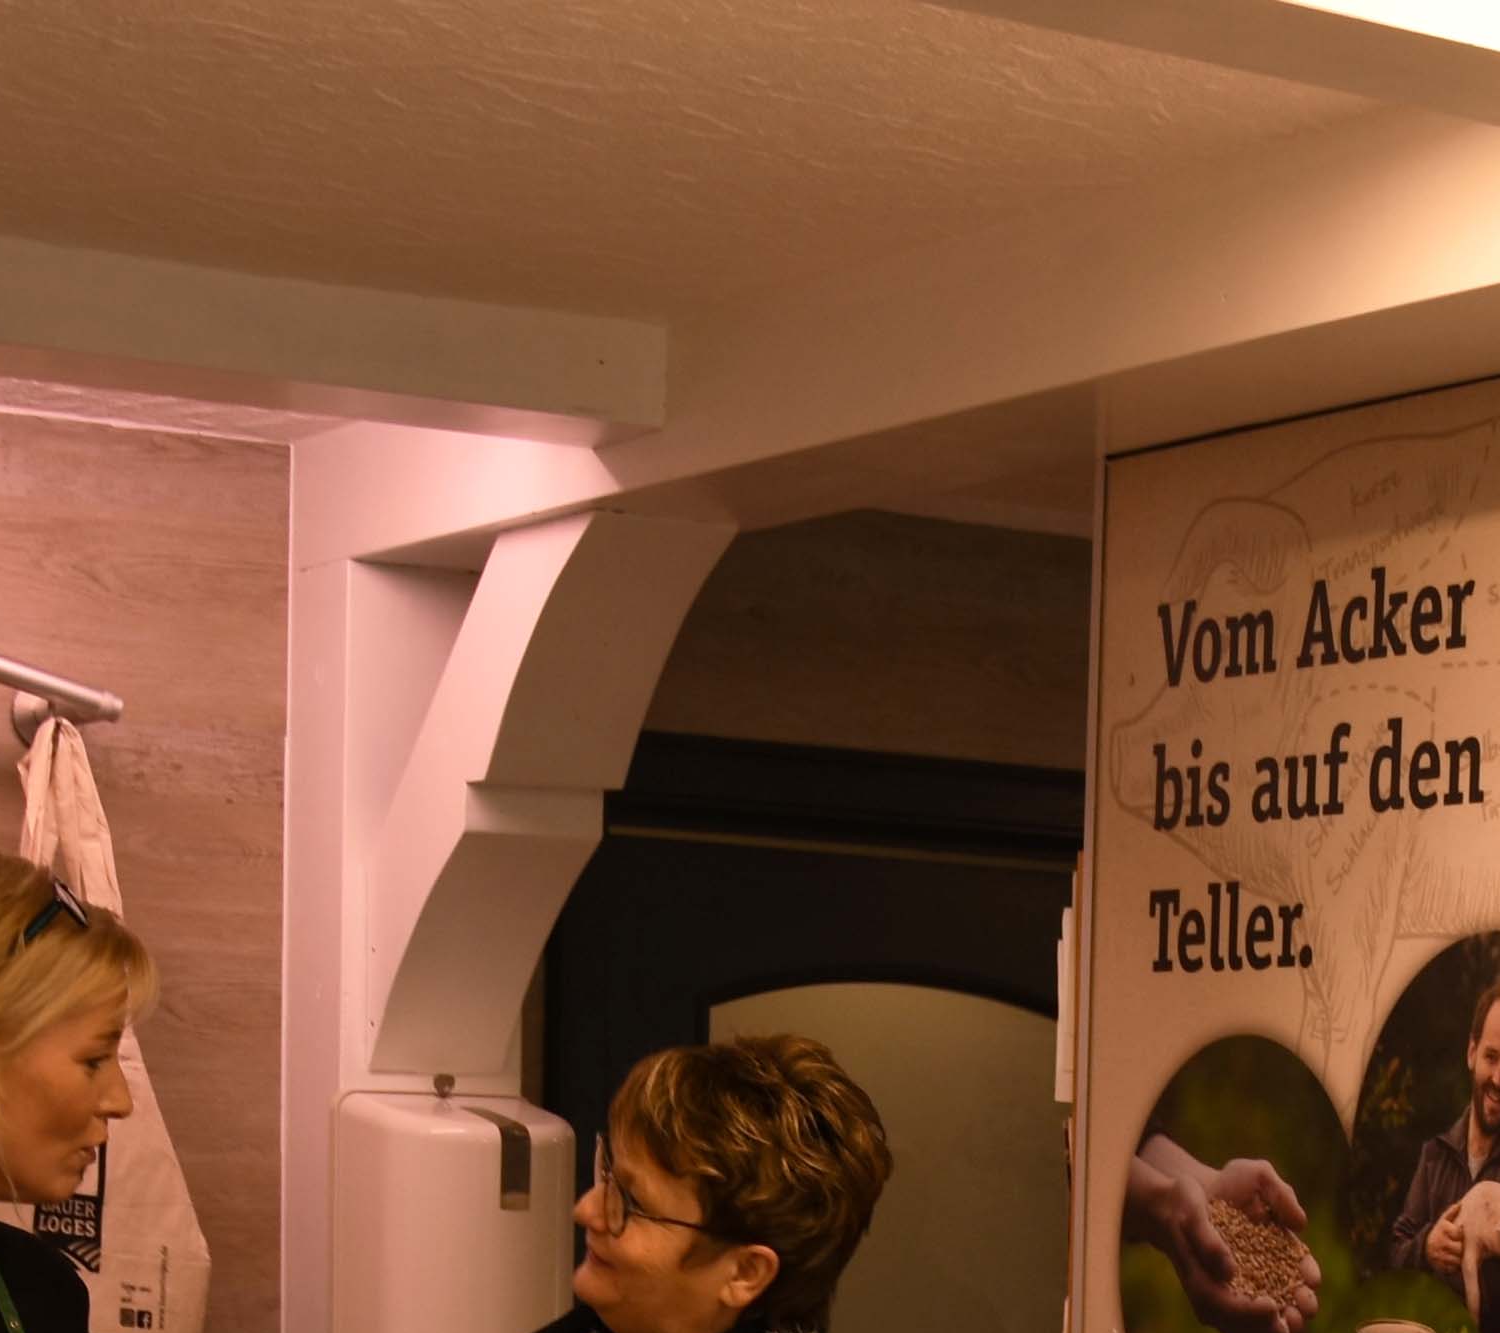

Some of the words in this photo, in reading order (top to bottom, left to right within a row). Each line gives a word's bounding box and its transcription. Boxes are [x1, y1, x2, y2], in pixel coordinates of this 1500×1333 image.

[1158, 599, 1276, 687] Vom
[1297, 566, 1476, 668] Acker
[1153, 739, 1230, 830] bis
[1251, 722, 1351, 823] auf
[1369, 717, 1484, 813] den
[1149, 881, 1313, 972] Teller.
[38, 1213, 96, 1237] LOGES
